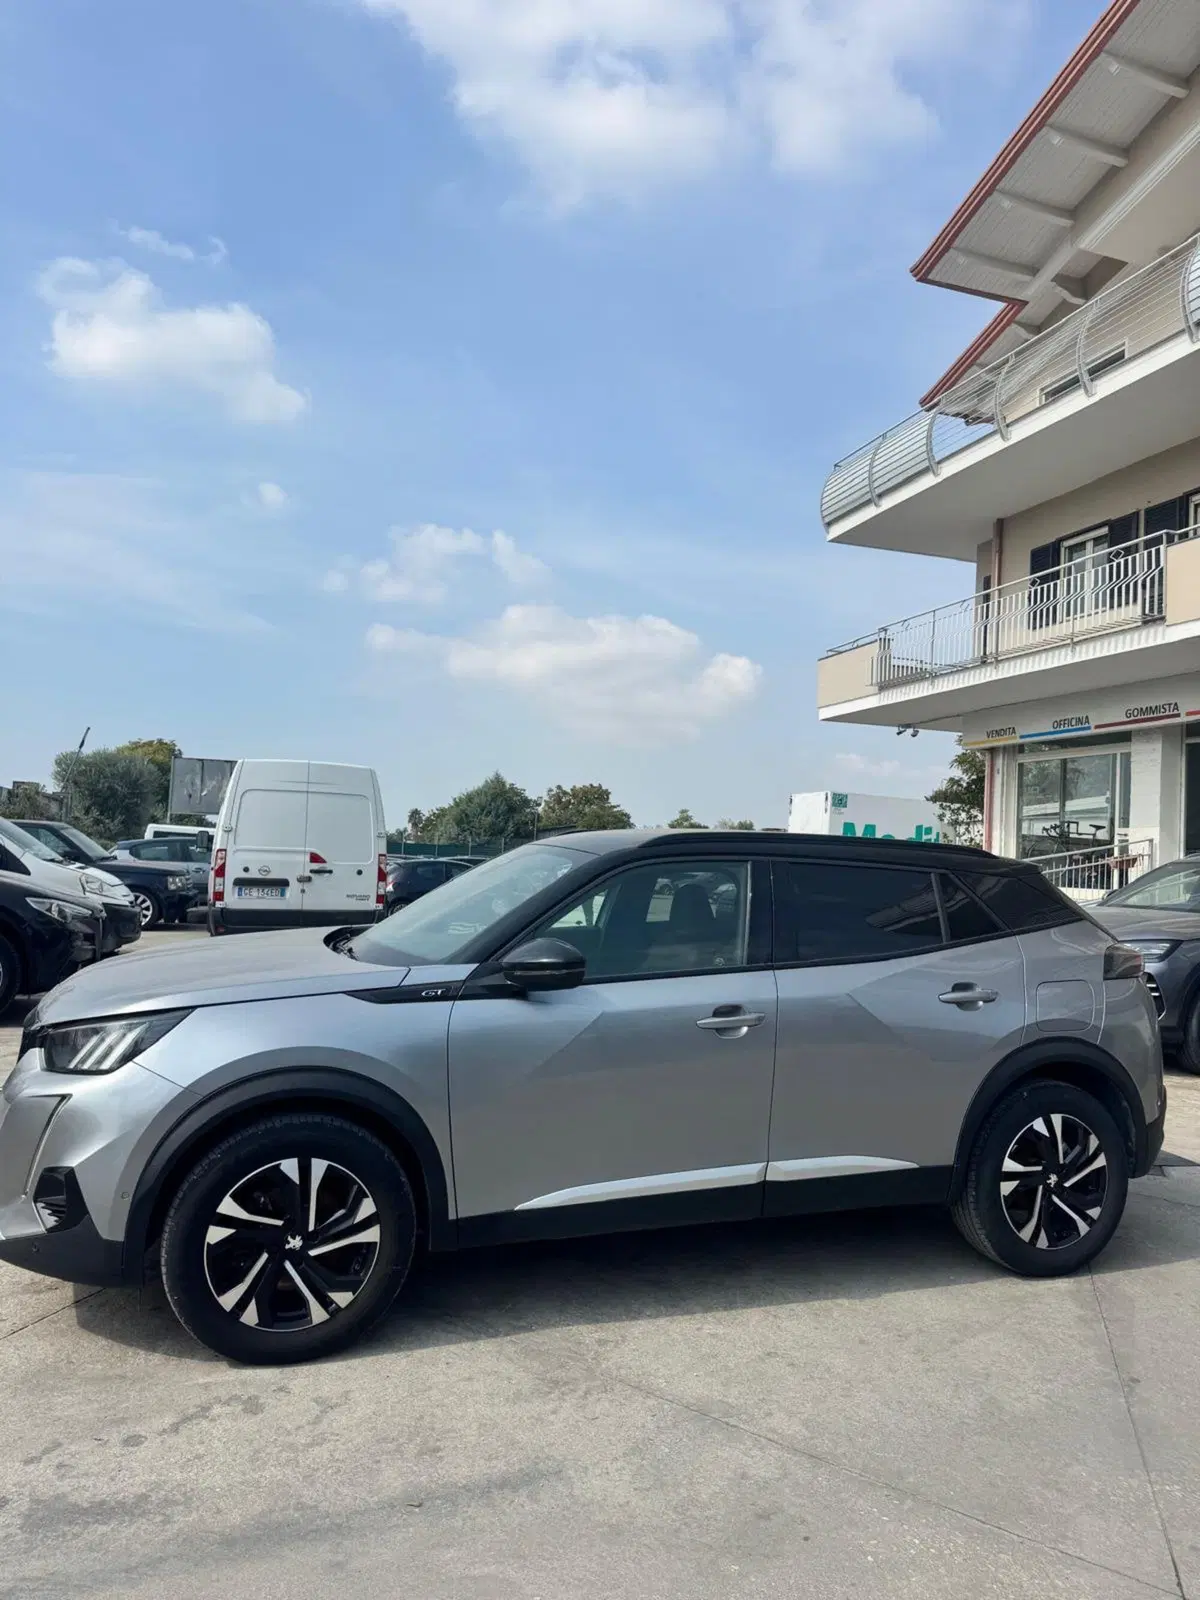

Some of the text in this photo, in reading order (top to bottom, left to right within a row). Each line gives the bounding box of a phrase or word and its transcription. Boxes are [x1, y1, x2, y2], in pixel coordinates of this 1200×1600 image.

[1125, 702, 1180, 719] GOMMISTA
[1052, 715, 1090, 730] OFFICINA
[986, 727, 1017, 739] VENDITA
[421, 988, 446, 997] GT
